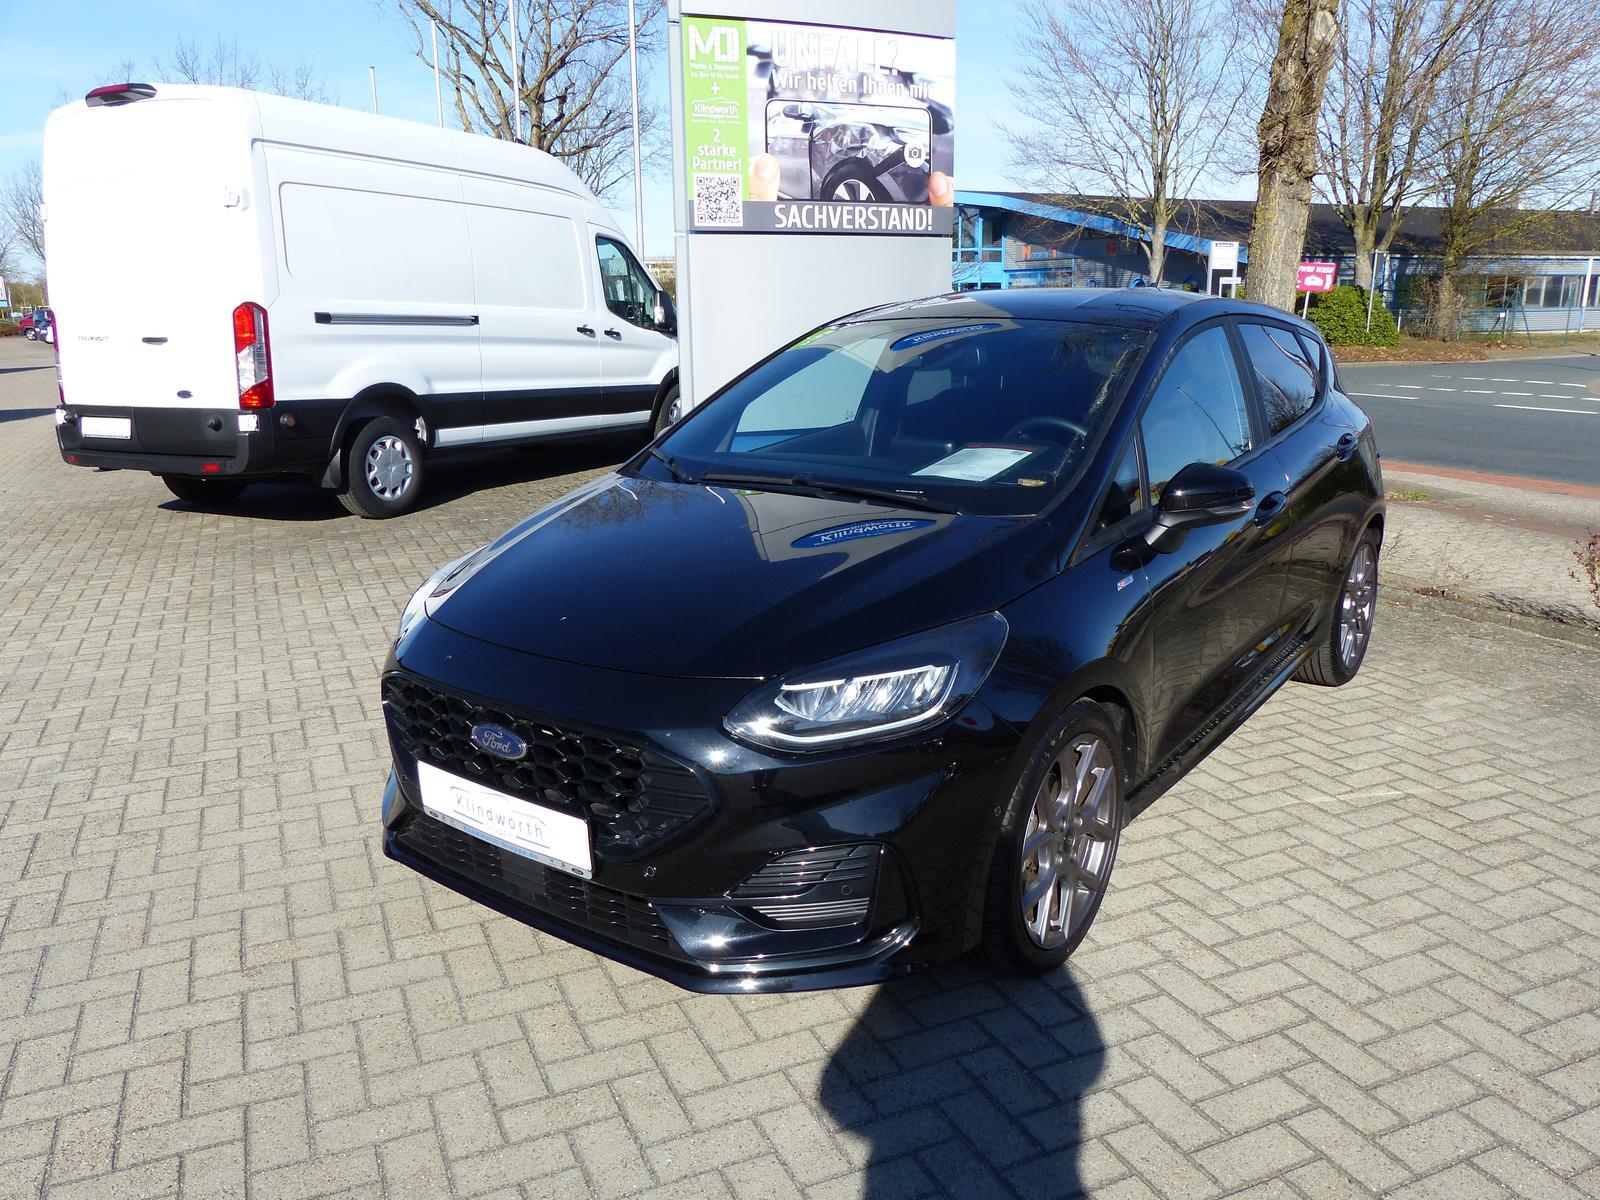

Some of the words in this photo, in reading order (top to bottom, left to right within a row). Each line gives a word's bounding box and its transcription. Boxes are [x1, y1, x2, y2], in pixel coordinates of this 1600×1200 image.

[771, 30, 899, 76] UNFALL?
[772, 68, 801, 90] Wir
[806, 72, 857, 94] helfen
[863, 75, 905, 98] Ihnen
[694, 103, 738, 115] Klindworth
[712, 128, 720, 142] 2
[697, 144, 737, 157] starke
[692, 156, 742, 171] Partner!
[774, 204, 933, 231] SACHVERSTAND!
[482, 730, 511, 753] Ford
[456, 793, 543, 839] Klindworth
